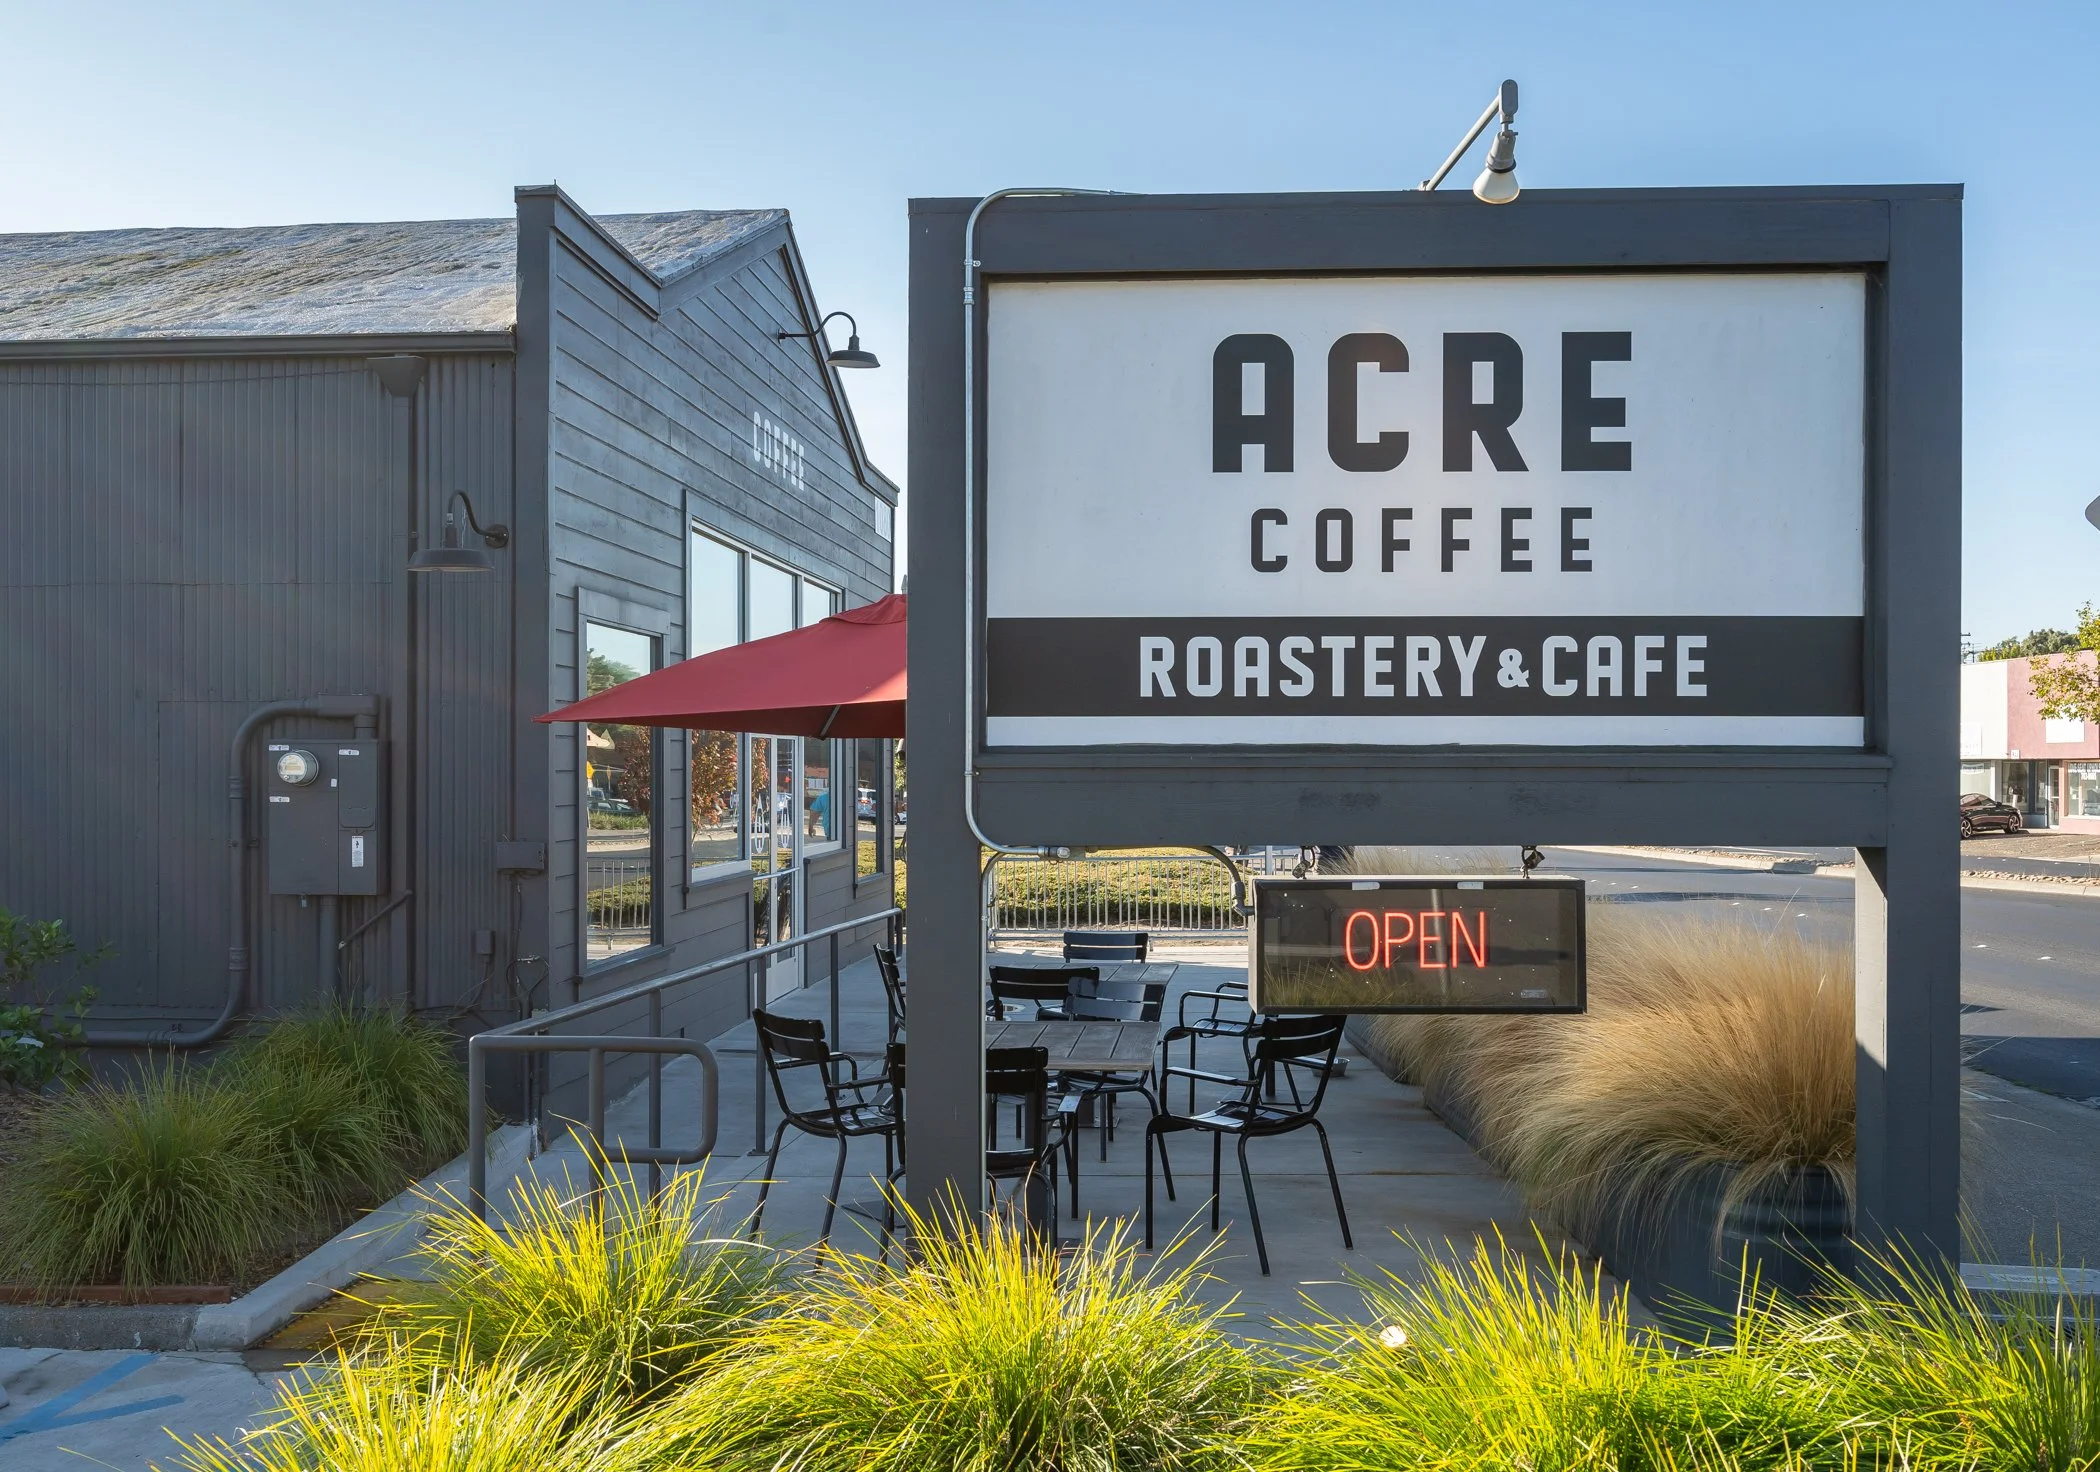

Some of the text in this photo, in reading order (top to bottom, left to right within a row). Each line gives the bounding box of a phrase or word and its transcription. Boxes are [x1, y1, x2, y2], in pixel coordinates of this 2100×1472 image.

[1213, 332, 1632, 472] ACRE
[753, 411, 804, 491] COFFEE
[1251, 507, 1593, 573] COFFEE
[1140, 636, 1708, 698] ROASTERY & CAFE
[1344, 909, 1488, 972] OPEN
